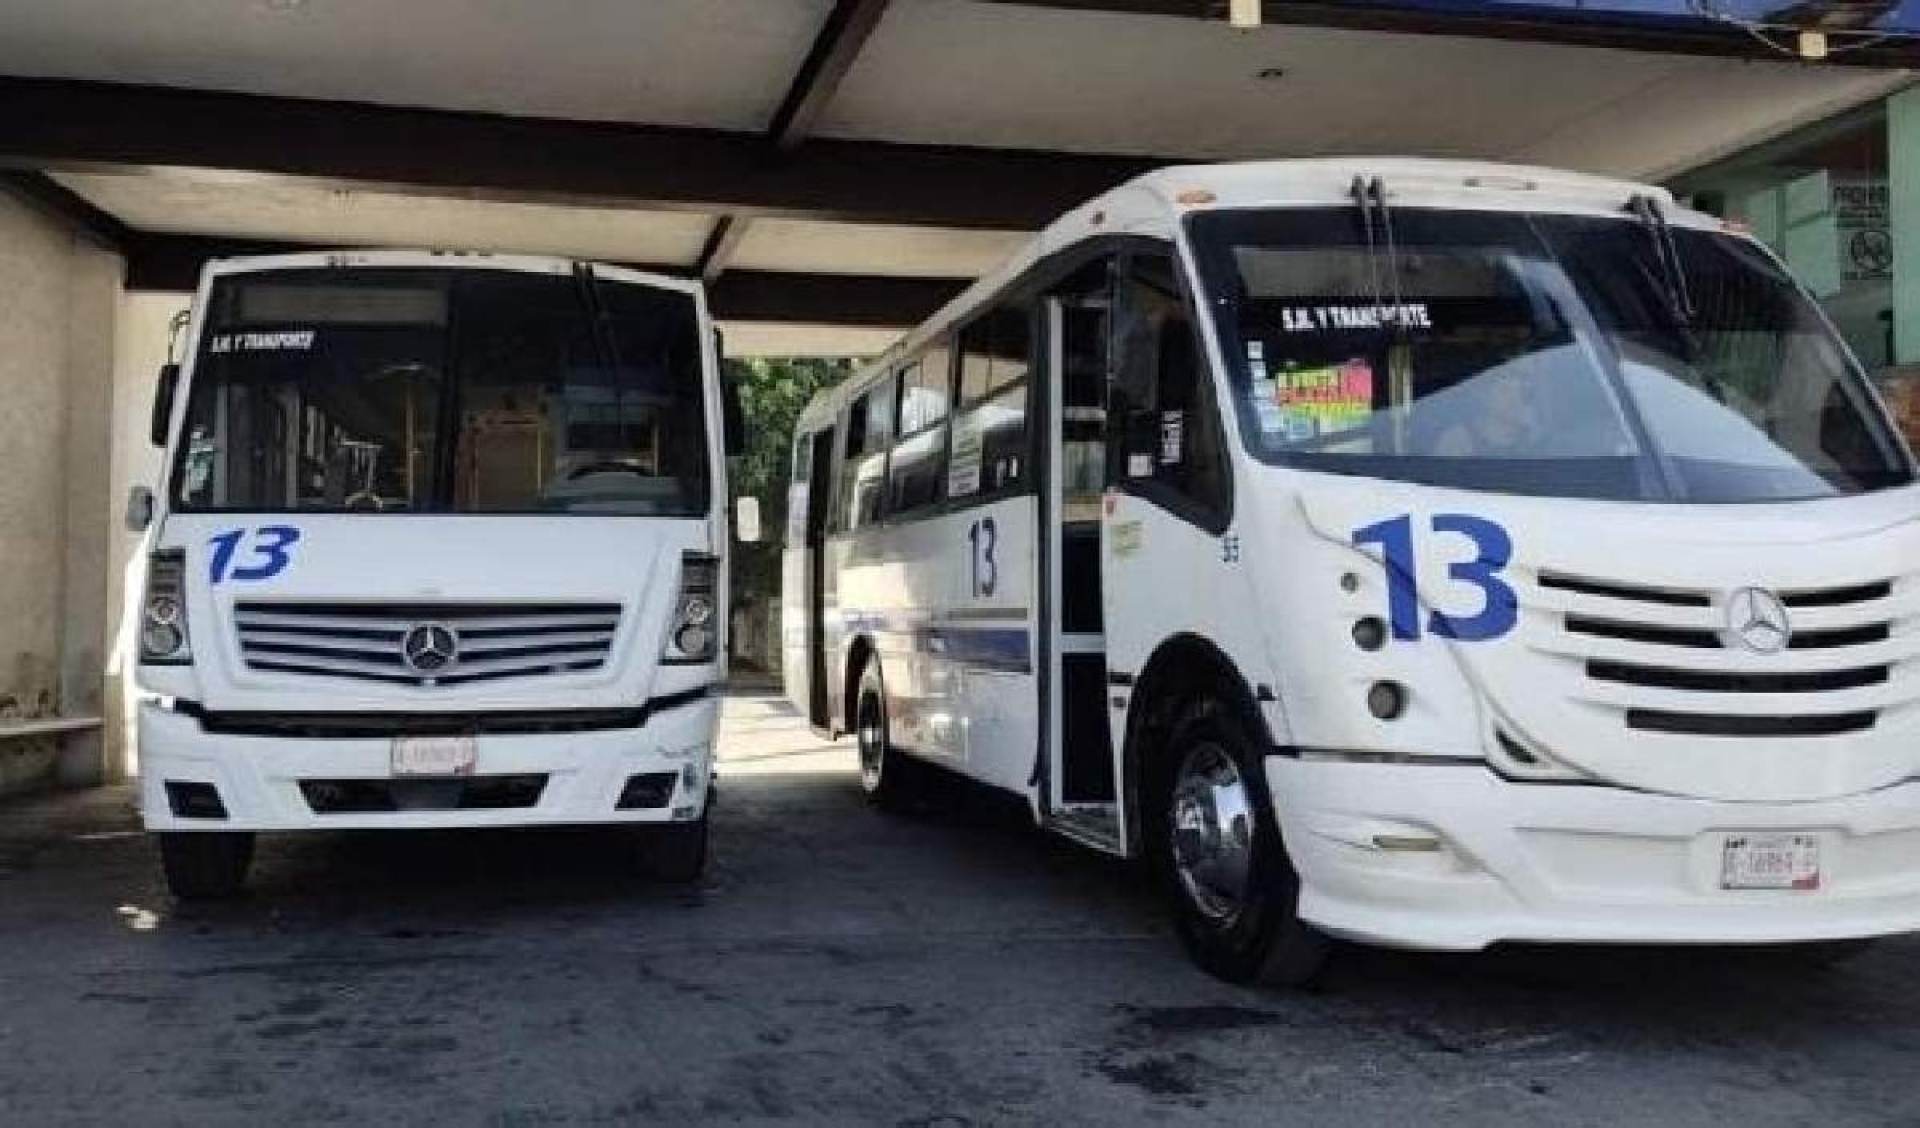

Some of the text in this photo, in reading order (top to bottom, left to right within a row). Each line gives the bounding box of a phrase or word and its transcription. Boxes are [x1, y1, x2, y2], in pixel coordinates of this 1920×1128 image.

[244, 331, 315, 350] TRANSPORTE
[208, 527, 301, 583] 13
[968, 517, 998, 597] 13
[1351, 513, 1519, 641] 13
